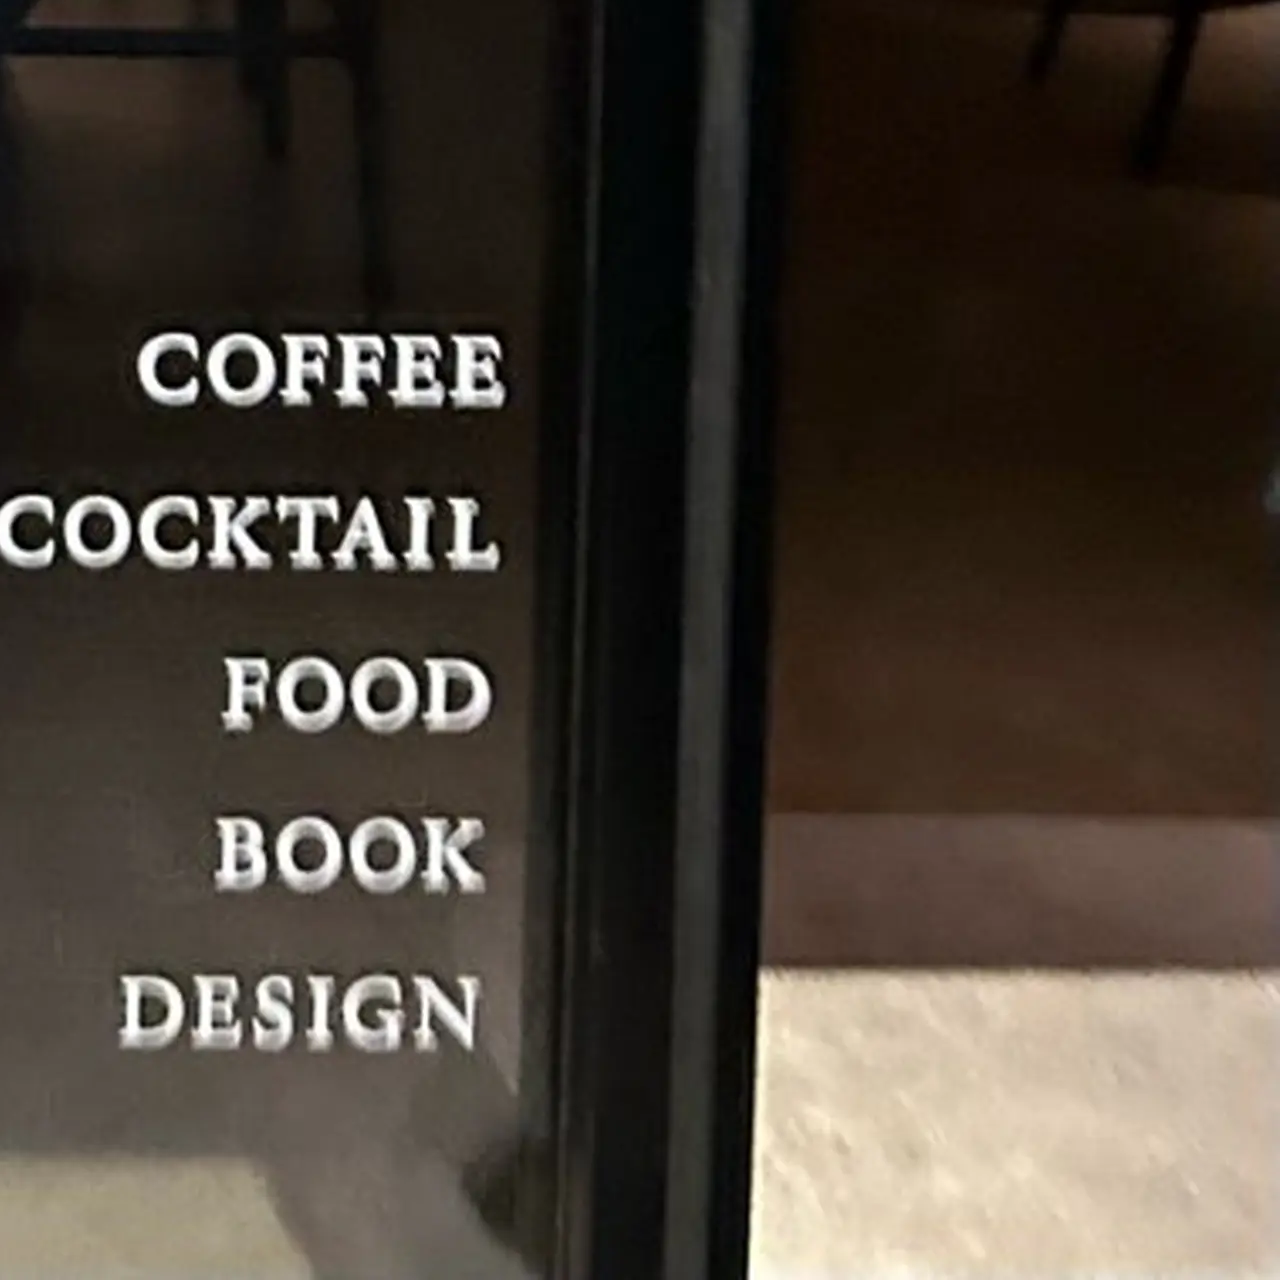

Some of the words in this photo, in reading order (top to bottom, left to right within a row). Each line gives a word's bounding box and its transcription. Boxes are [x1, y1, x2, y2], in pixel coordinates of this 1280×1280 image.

[137, 331, 506, 408] COFFEE
[220, 656, 492, 732] FOOD
[214, 816, 484, 893] BOOK
[118, 974, 480, 1051] DESIGN
